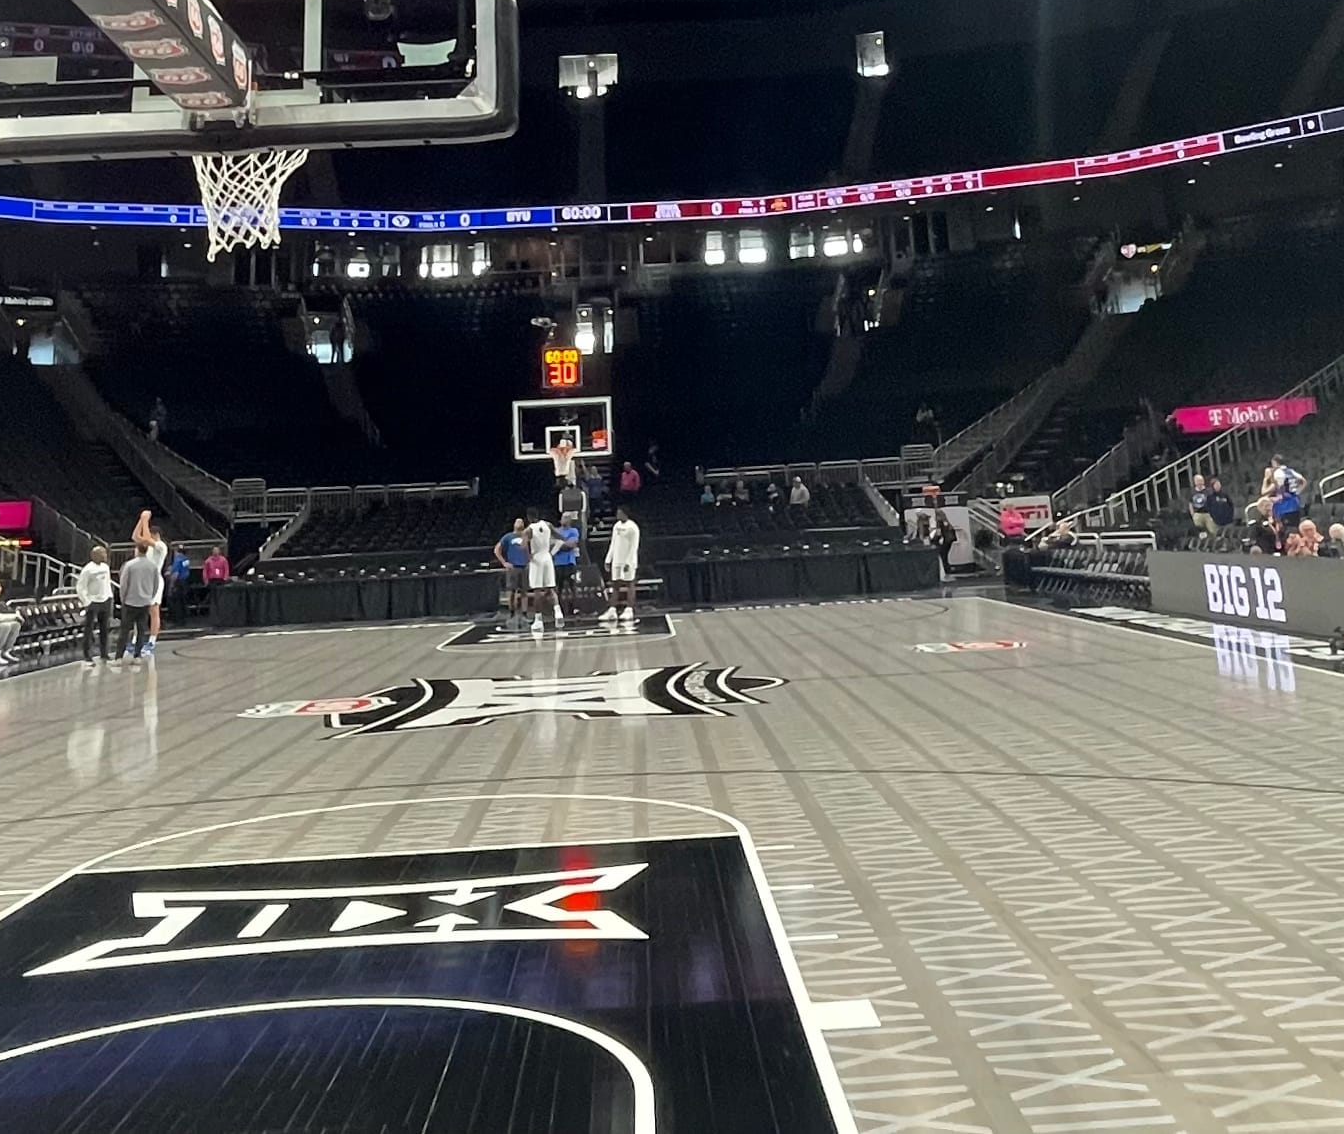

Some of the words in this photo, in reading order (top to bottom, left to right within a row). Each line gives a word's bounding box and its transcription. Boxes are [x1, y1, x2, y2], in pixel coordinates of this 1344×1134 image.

[545, 350, 578, 363] 60:00
[550, 362, 578, 384] 30
[1203, 563, 1250, 617] BIG
[1250, 566, 1287, 623] 12
